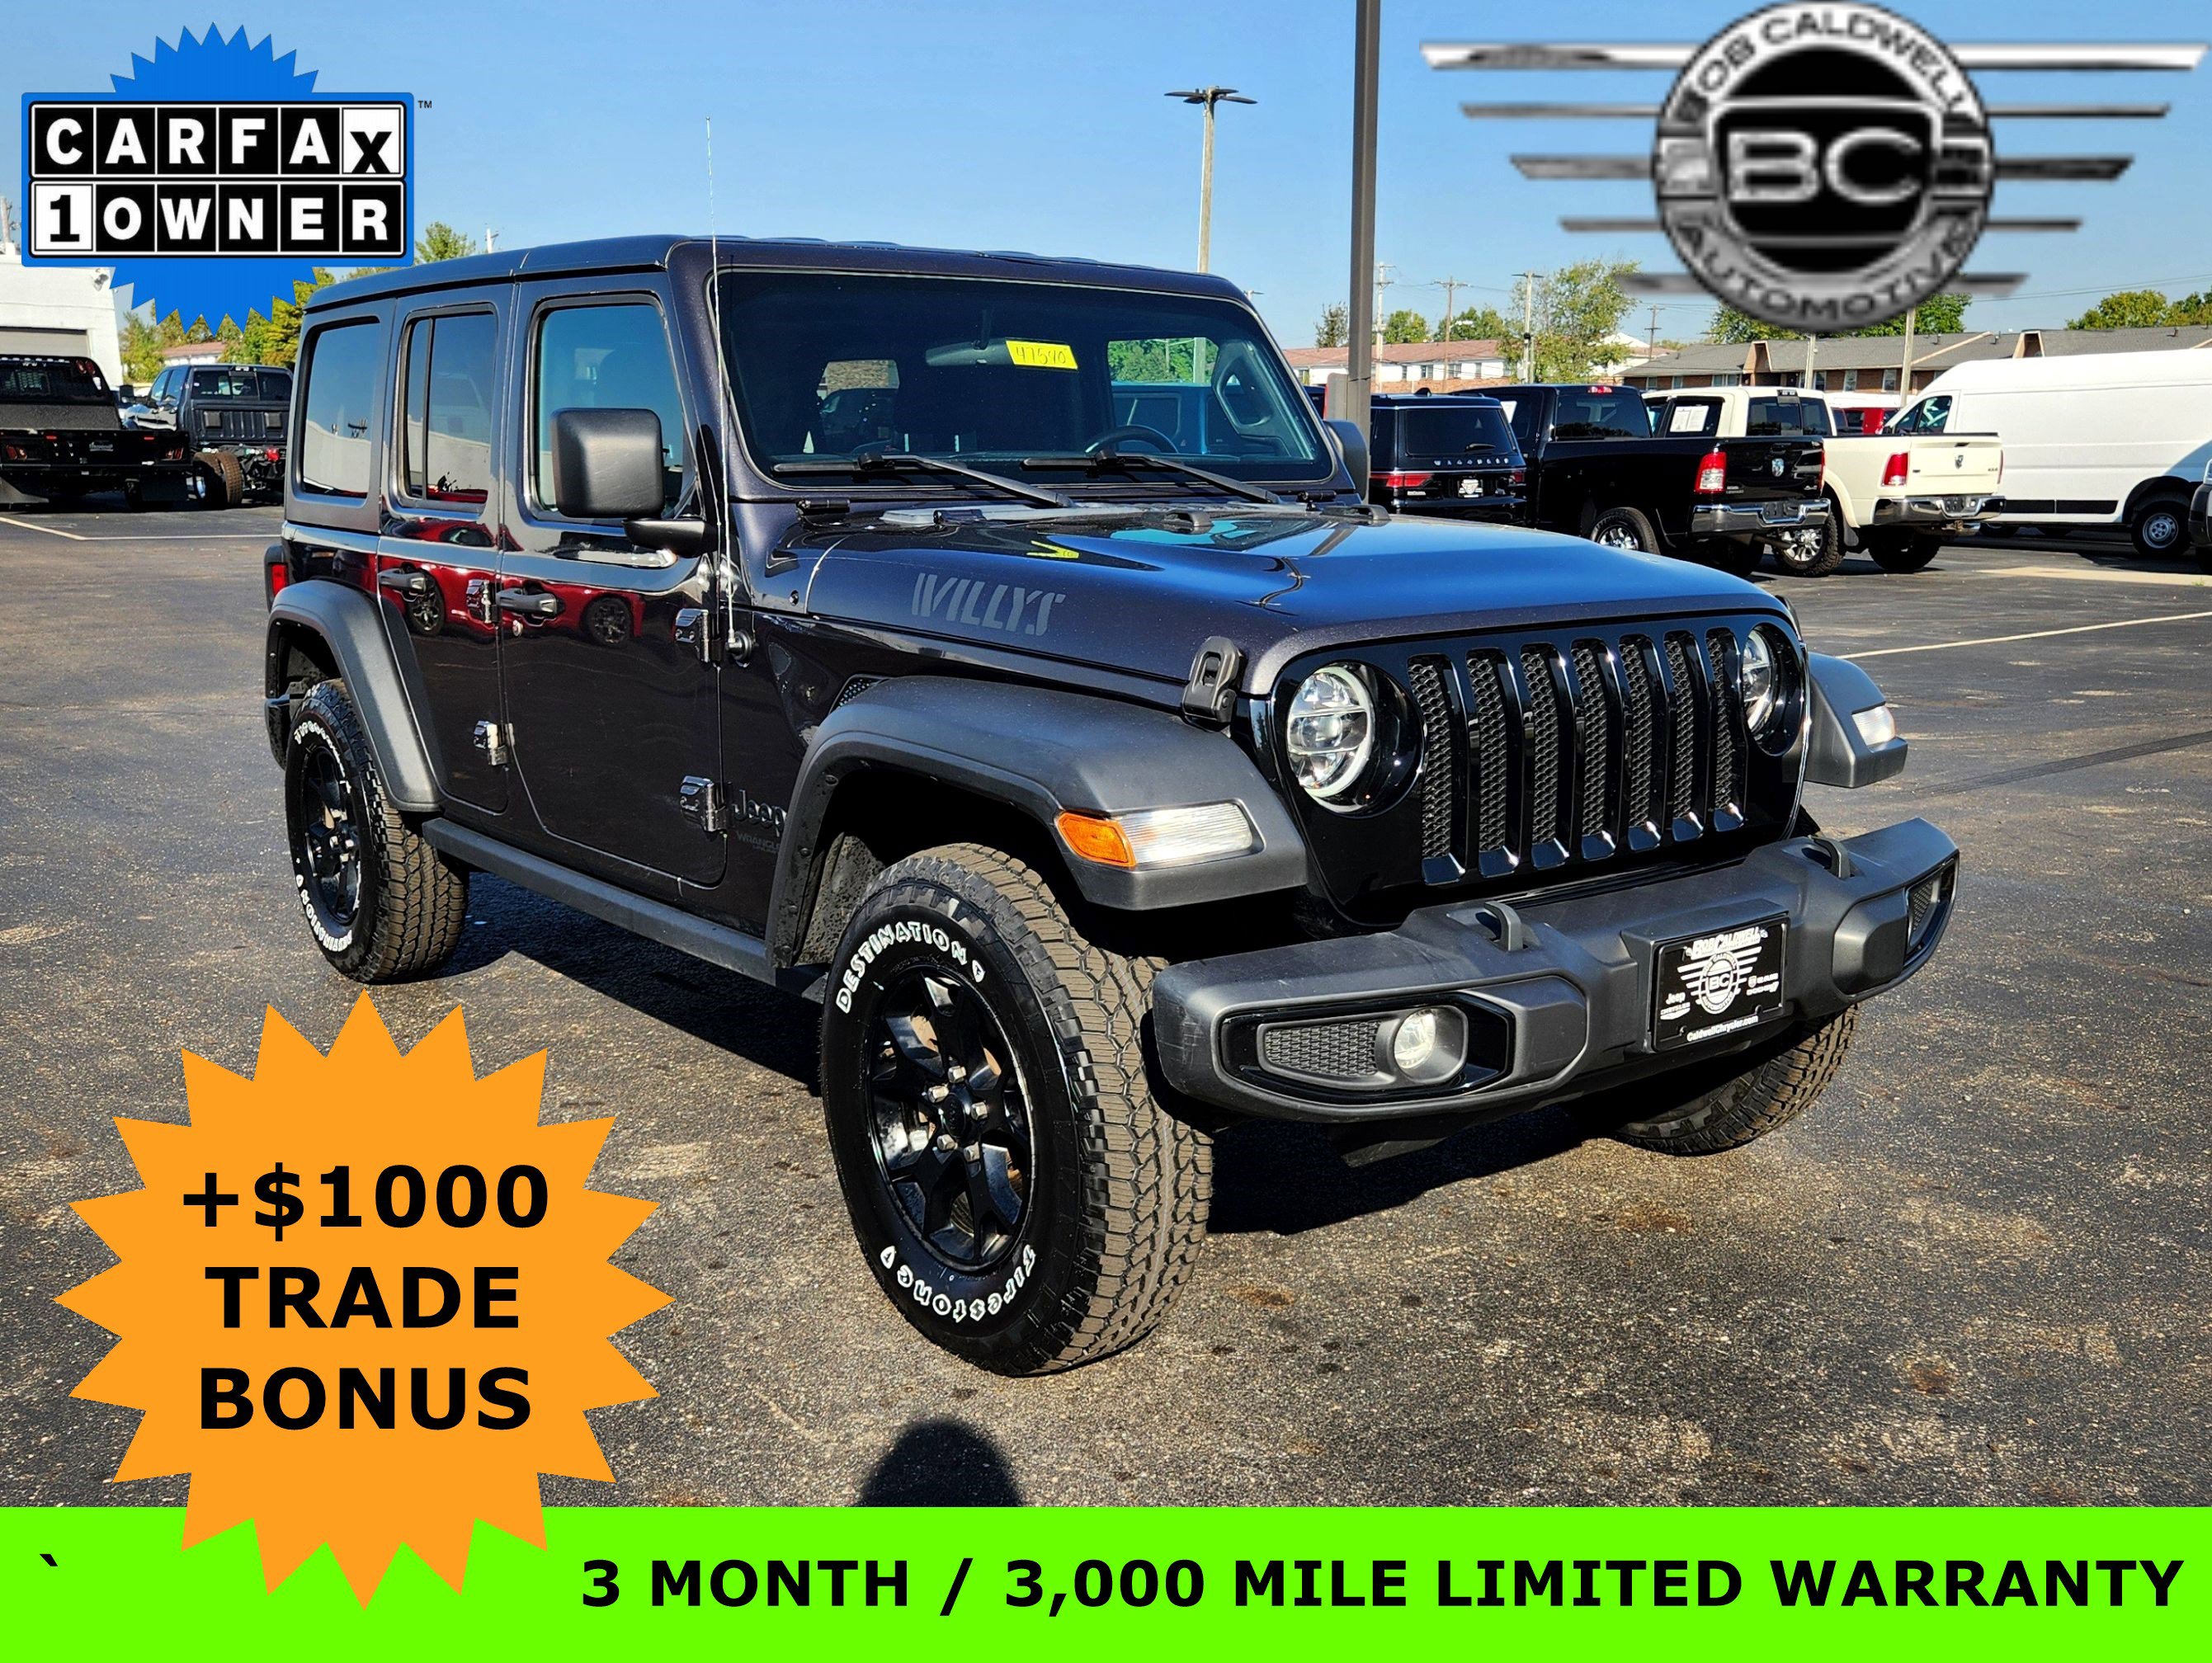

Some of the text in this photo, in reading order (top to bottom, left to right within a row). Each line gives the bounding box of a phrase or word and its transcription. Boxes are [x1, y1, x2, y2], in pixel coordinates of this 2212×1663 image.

[912, 572, 1066, 636] WILLYS
[731, 789, 787, 837] Jeep
[836, 921, 968, 1014] DESTINATION
[1665, 992, 1686, 1005] Jeep
